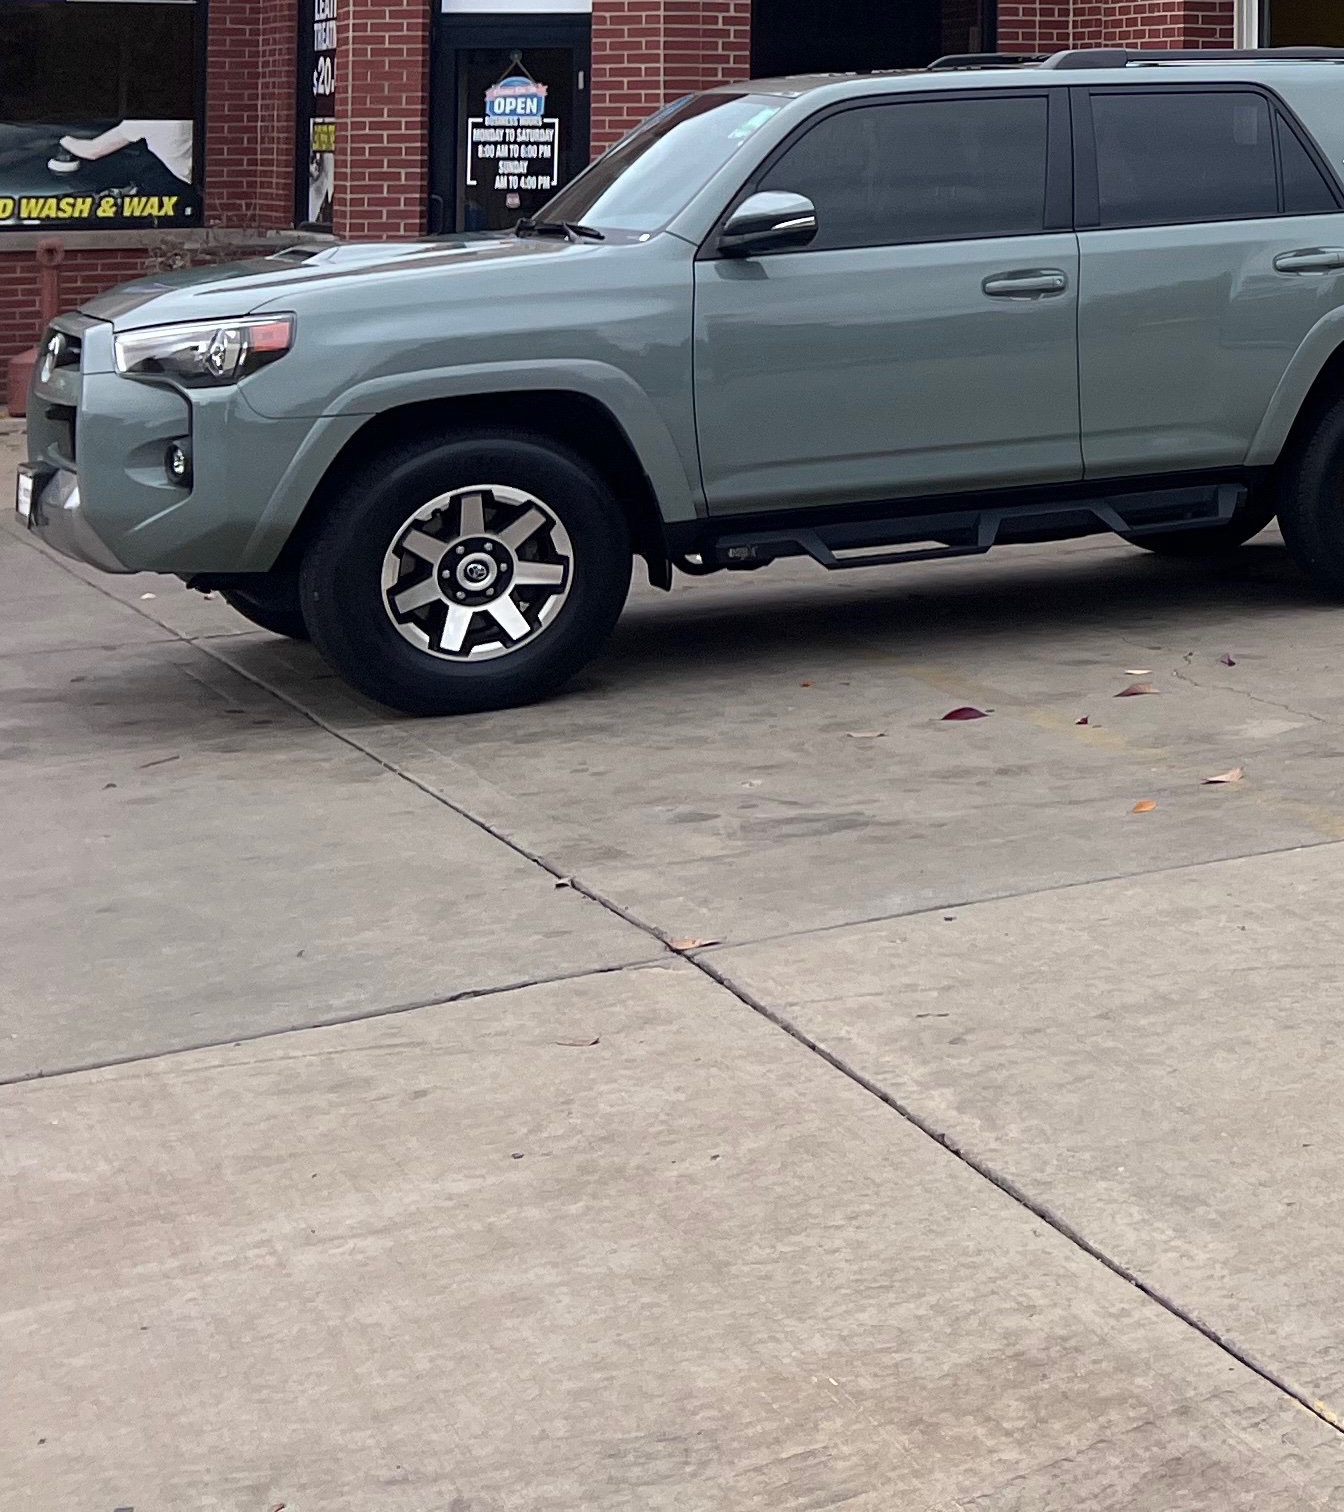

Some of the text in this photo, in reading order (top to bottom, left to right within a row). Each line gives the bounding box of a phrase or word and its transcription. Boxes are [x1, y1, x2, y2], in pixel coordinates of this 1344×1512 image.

[313, 56, 337, 97] $20.
[493, 97, 538, 115] OPEN
[19, 196, 93, 218] WASH
[96, 196, 117, 217] &
[123, 196, 178, 217] WAX
